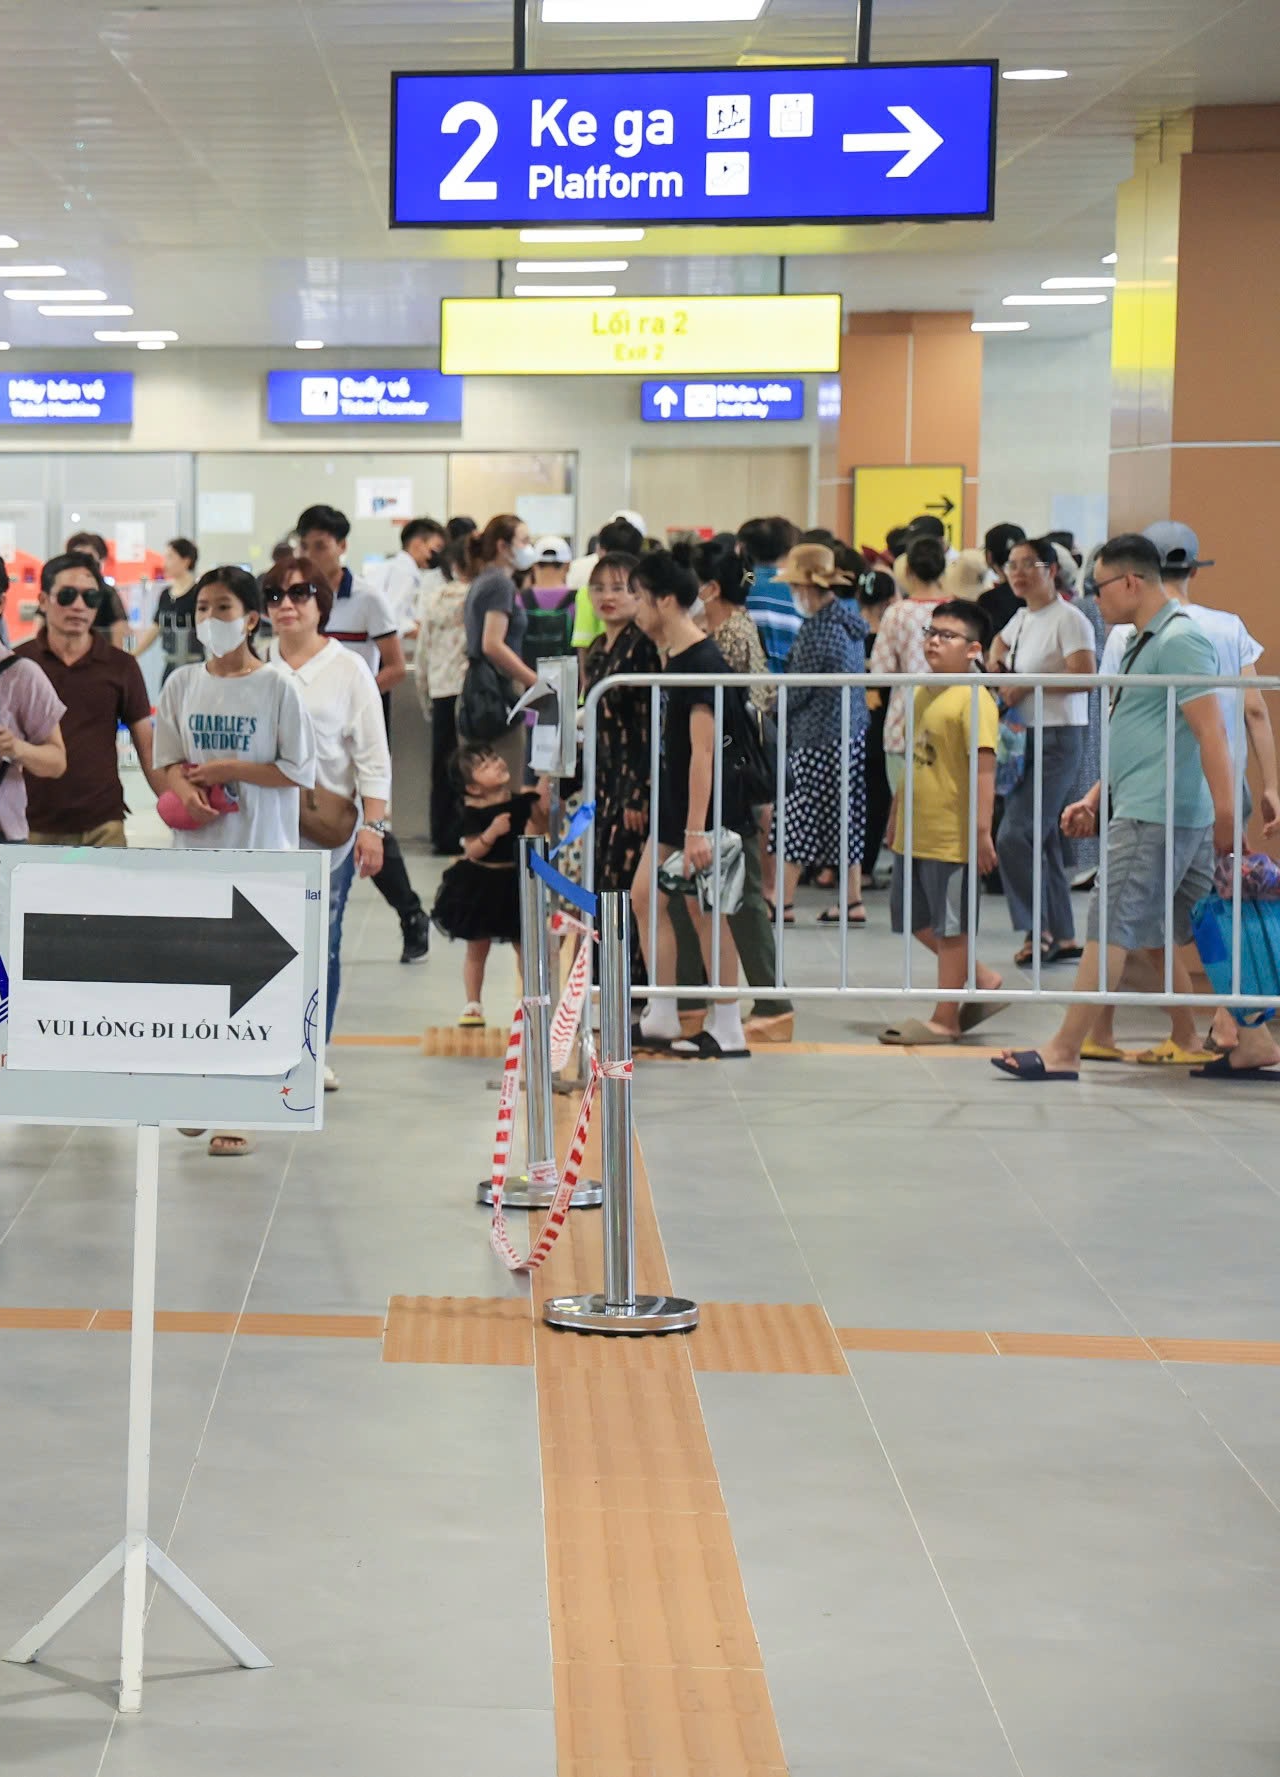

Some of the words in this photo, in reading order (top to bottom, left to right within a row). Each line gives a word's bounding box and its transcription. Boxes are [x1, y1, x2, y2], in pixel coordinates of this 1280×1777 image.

[531, 98, 598, 147] Ke
[614, 109, 675, 158] ga
[439, 101, 499, 200] 2
[528, 164, 684, 200] Platform
[592, 309, 631, 336] Lối
[639, 317, 665, 335] ra
[673, 310, 689, 335] 2
[188, 713, 258, 735] CHARLIE'S
[36, 1019, 76, 1036] VUI
[81, 1015, 145, 1038] LÒNG
[150, 1022, 174, 1039] ĐI
[181, 1018, 219, 1040] LỐI
[226, 1019, 273, 1041] NÀY
